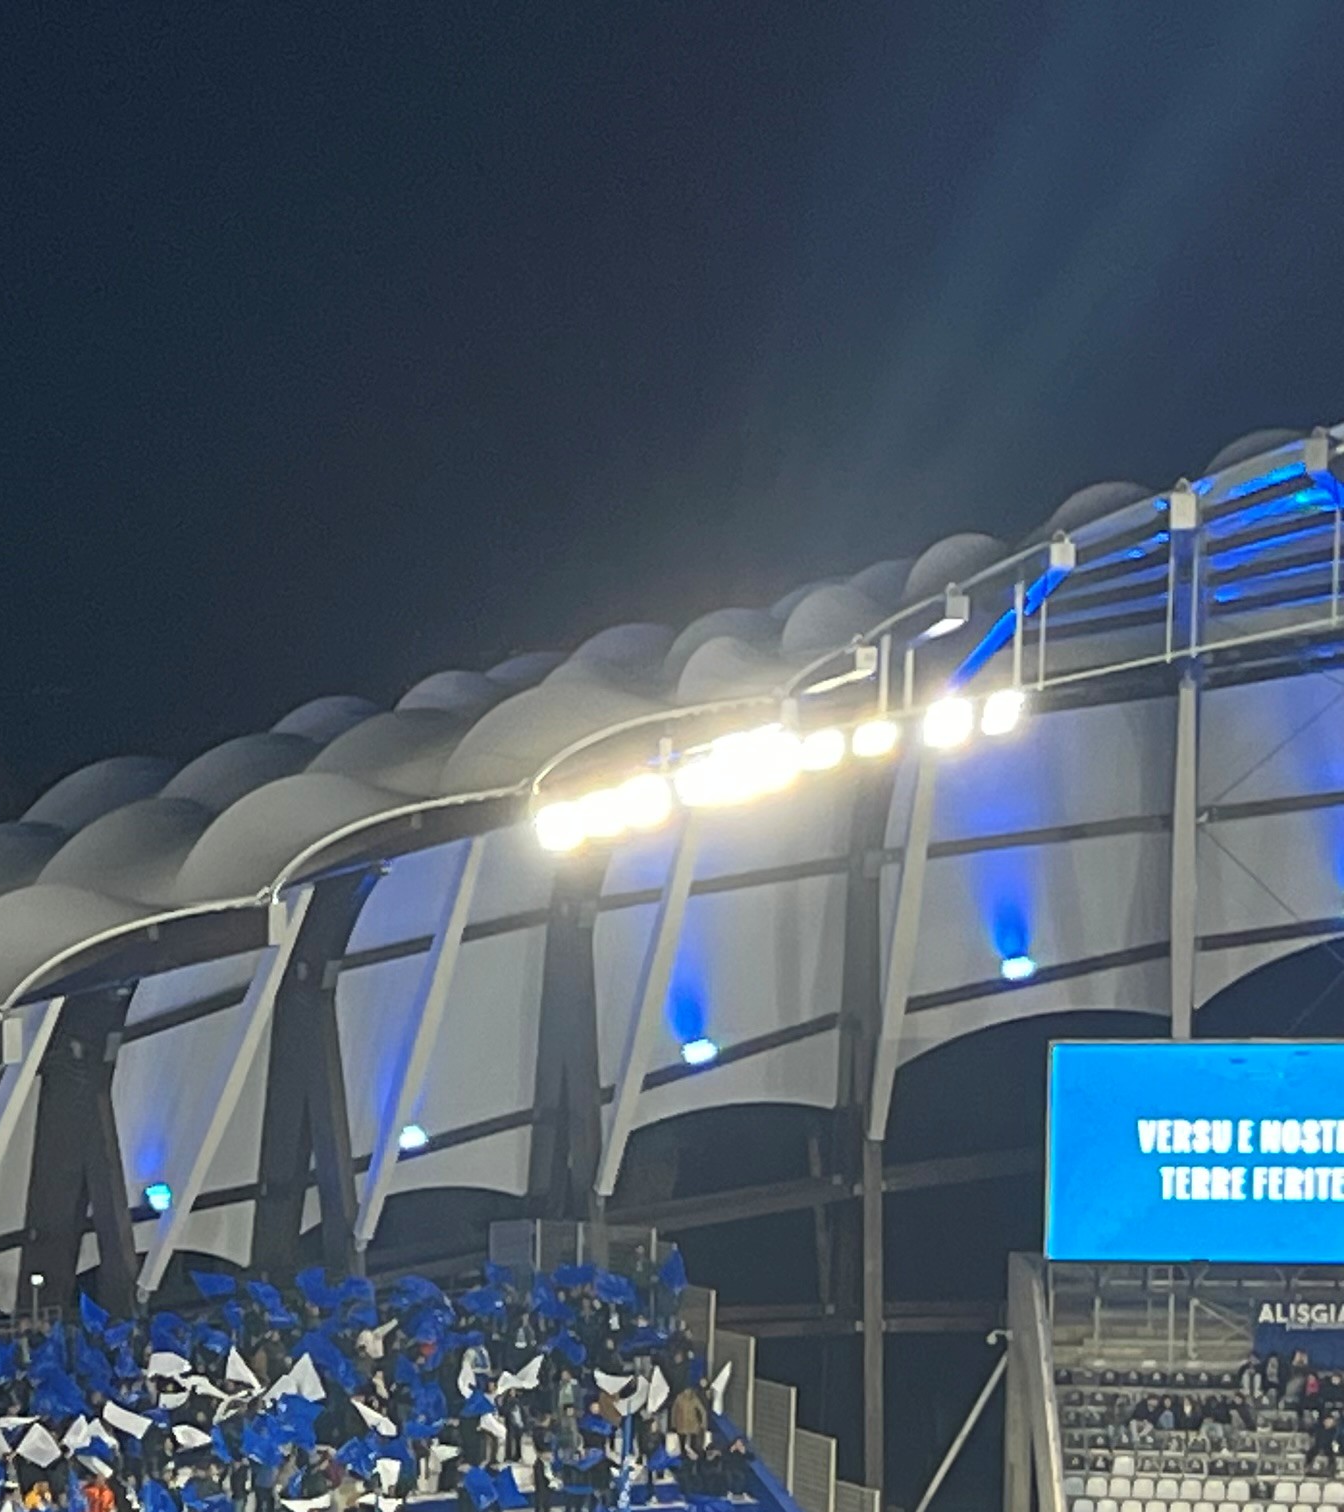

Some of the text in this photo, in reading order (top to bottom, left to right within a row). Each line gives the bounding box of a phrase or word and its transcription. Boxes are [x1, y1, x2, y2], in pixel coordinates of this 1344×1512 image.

[1137, 1118, 1233, 1154] VERSU
[1237, 1119, 1256, 1154] E
[1159, 1166, 1344, 1201] TERRE FERITE
